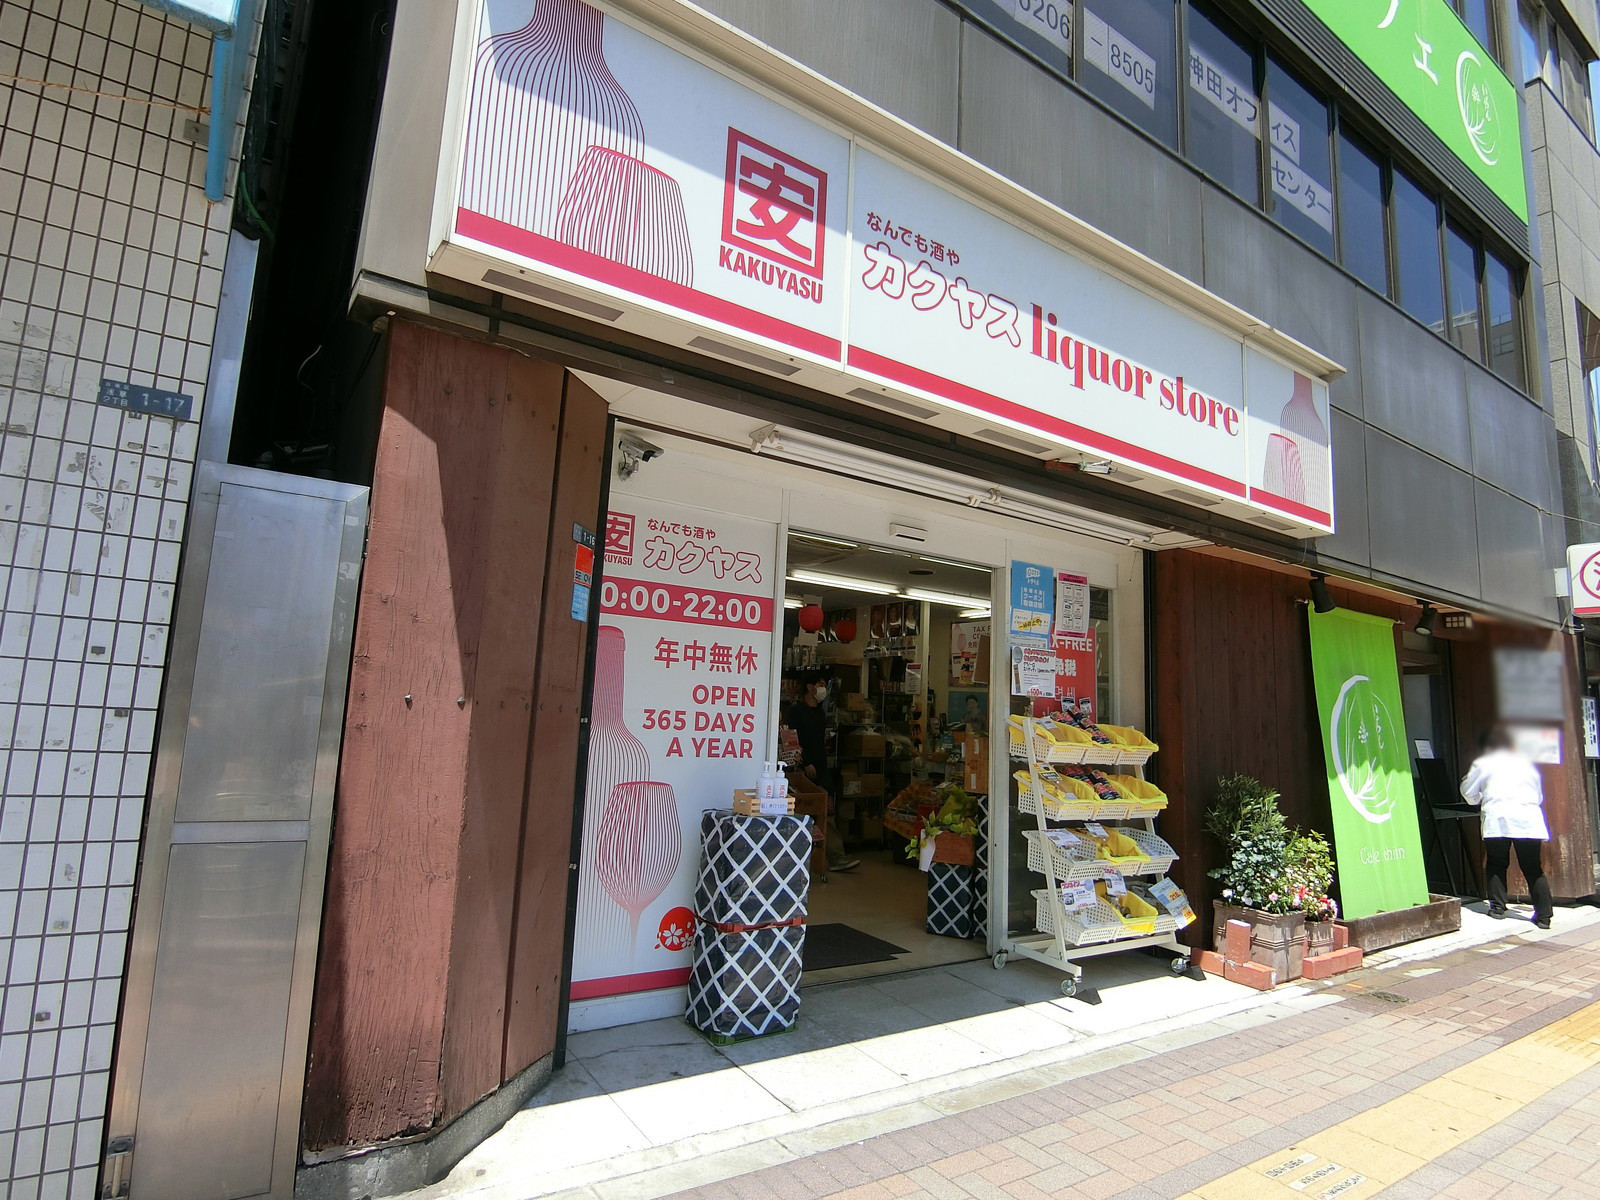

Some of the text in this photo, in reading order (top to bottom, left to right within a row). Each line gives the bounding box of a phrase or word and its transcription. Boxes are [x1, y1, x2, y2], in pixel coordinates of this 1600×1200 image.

[736, 154, 815, 262] 安
[1272, 160, 1330, 215] センター
[866, 211, 960, 266] なんでも酒や
[719, 245, 823, 304] KAKUYASU
[862, 241, 1021, 348] カクヤス
[1030, 302, 1239, 437] liquor store
[142, 393, 184, 412] 1-17
[647, 518, 716, 541] なんでも酒や
[643, 535, 762, 583] カクヤス
[654, 637, 758, 675] 年中無休
[692, 684, 756, 707] OPEN
[642, 709, 755, 733] 365 DAYS
[666, 737, 753, 758] A YEAR
